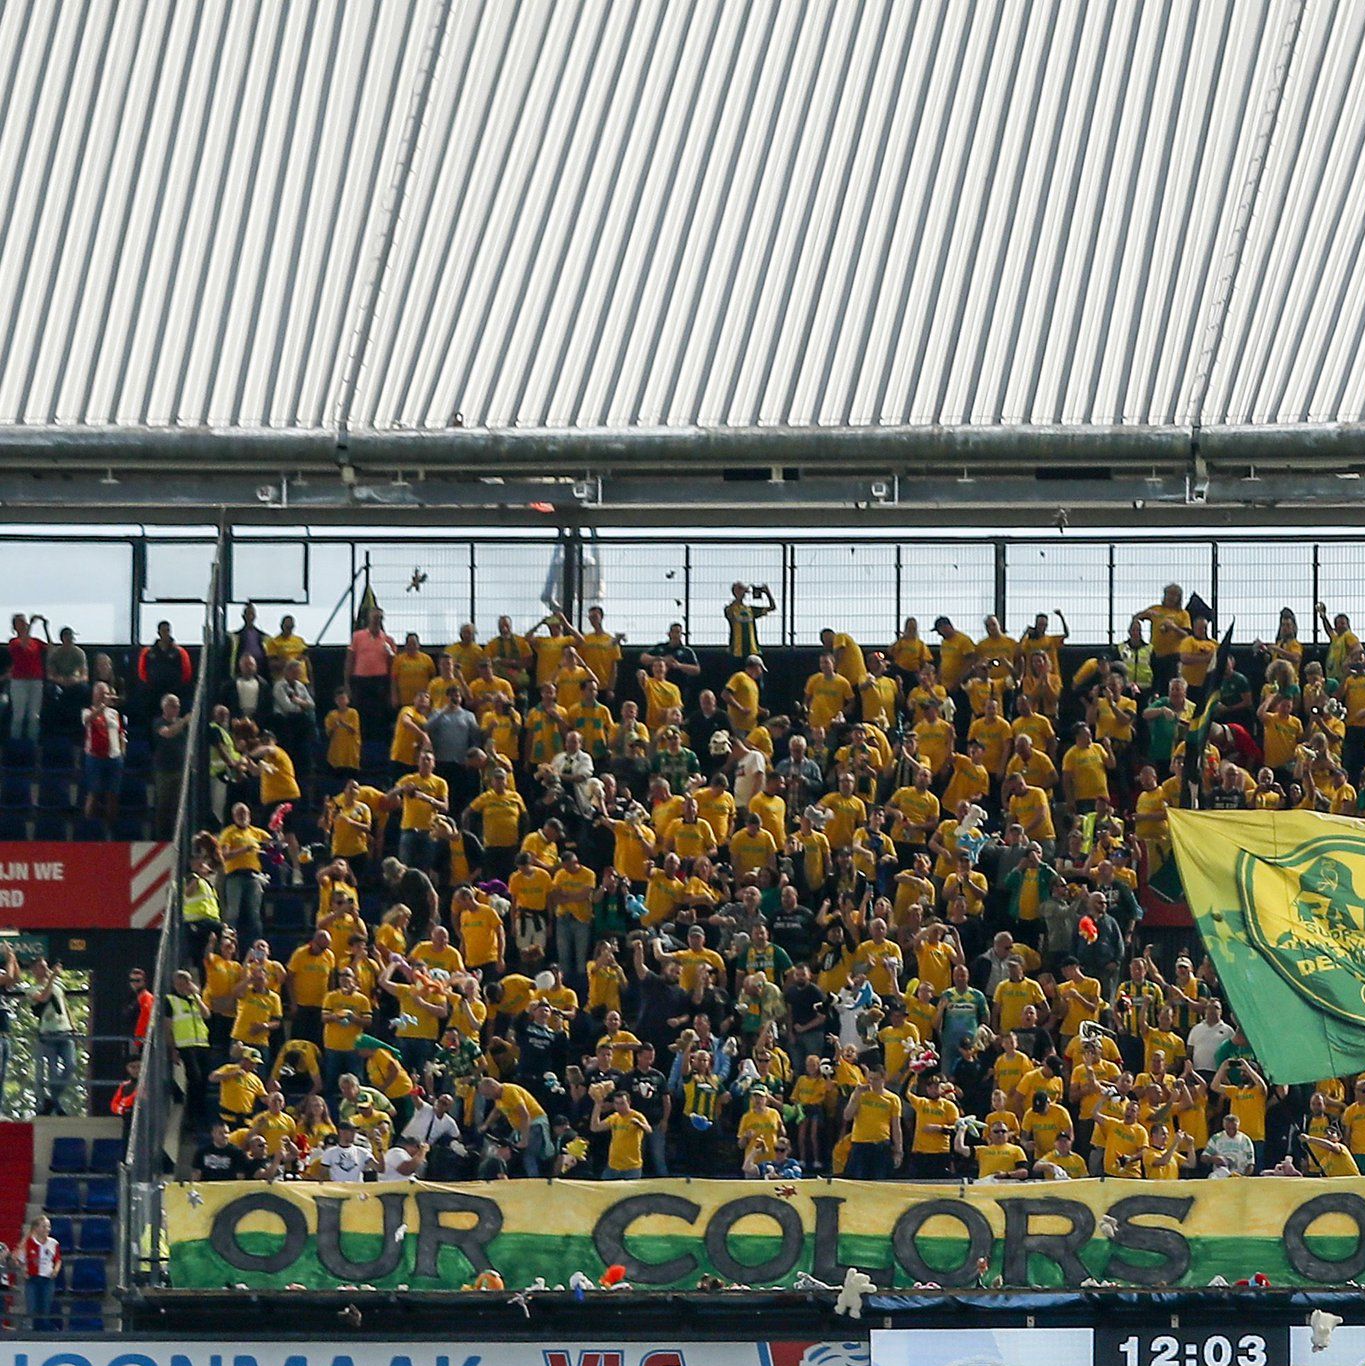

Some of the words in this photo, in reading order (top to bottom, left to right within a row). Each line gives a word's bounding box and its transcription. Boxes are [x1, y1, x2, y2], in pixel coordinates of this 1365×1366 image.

[34, 862, 64, 881] WE
[210, 1191, 505, 1282] OUR
[592, 1191, 1196, 1288] COLORS
